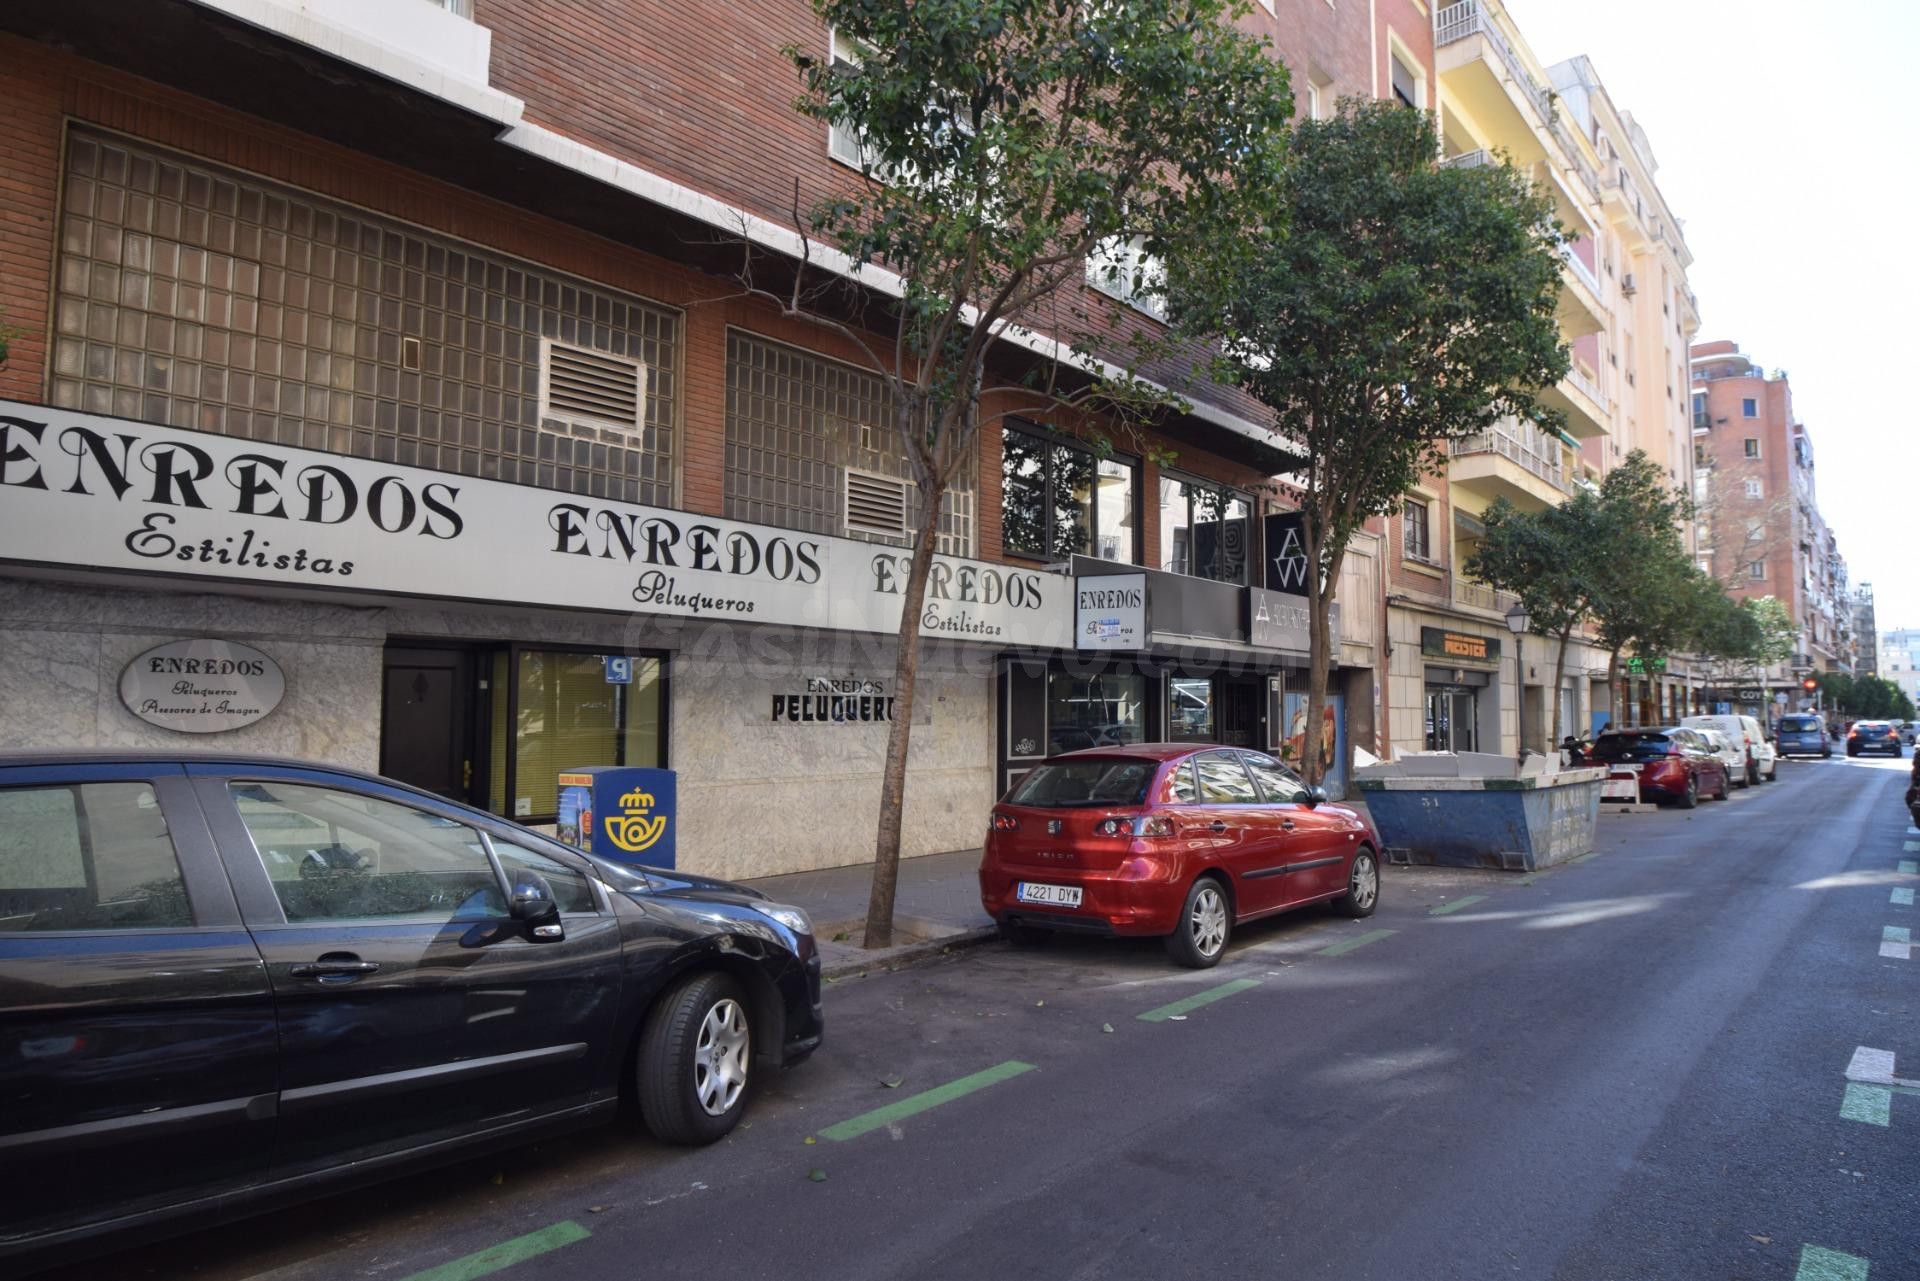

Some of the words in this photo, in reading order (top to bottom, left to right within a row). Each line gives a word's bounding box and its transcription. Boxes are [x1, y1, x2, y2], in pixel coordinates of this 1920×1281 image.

[0, 415, 464, 540] ENREDOS
[125, 512, 354, 576] Estilistas
[548, 503, 822, 584] ENREDOS
[632, 570, 755, 613] Peluqueros
[1080, 589, 1142, 609] ENREDOS
[922, 603, 1001, 636] Estilistas
[149, 657, 264, 676] ENREDOS
[171, 680, 238, 697] Peluqueros
[807, 678, 884, 694] ENREDOS
[140, 699, 196, 714] Asesores
[199, 702, 212, 714] de
[215, 700, 260, 716] Imagen
[1026, 885, 1052, 901] 4221
[1058, 888, 1079, 903] DYW
